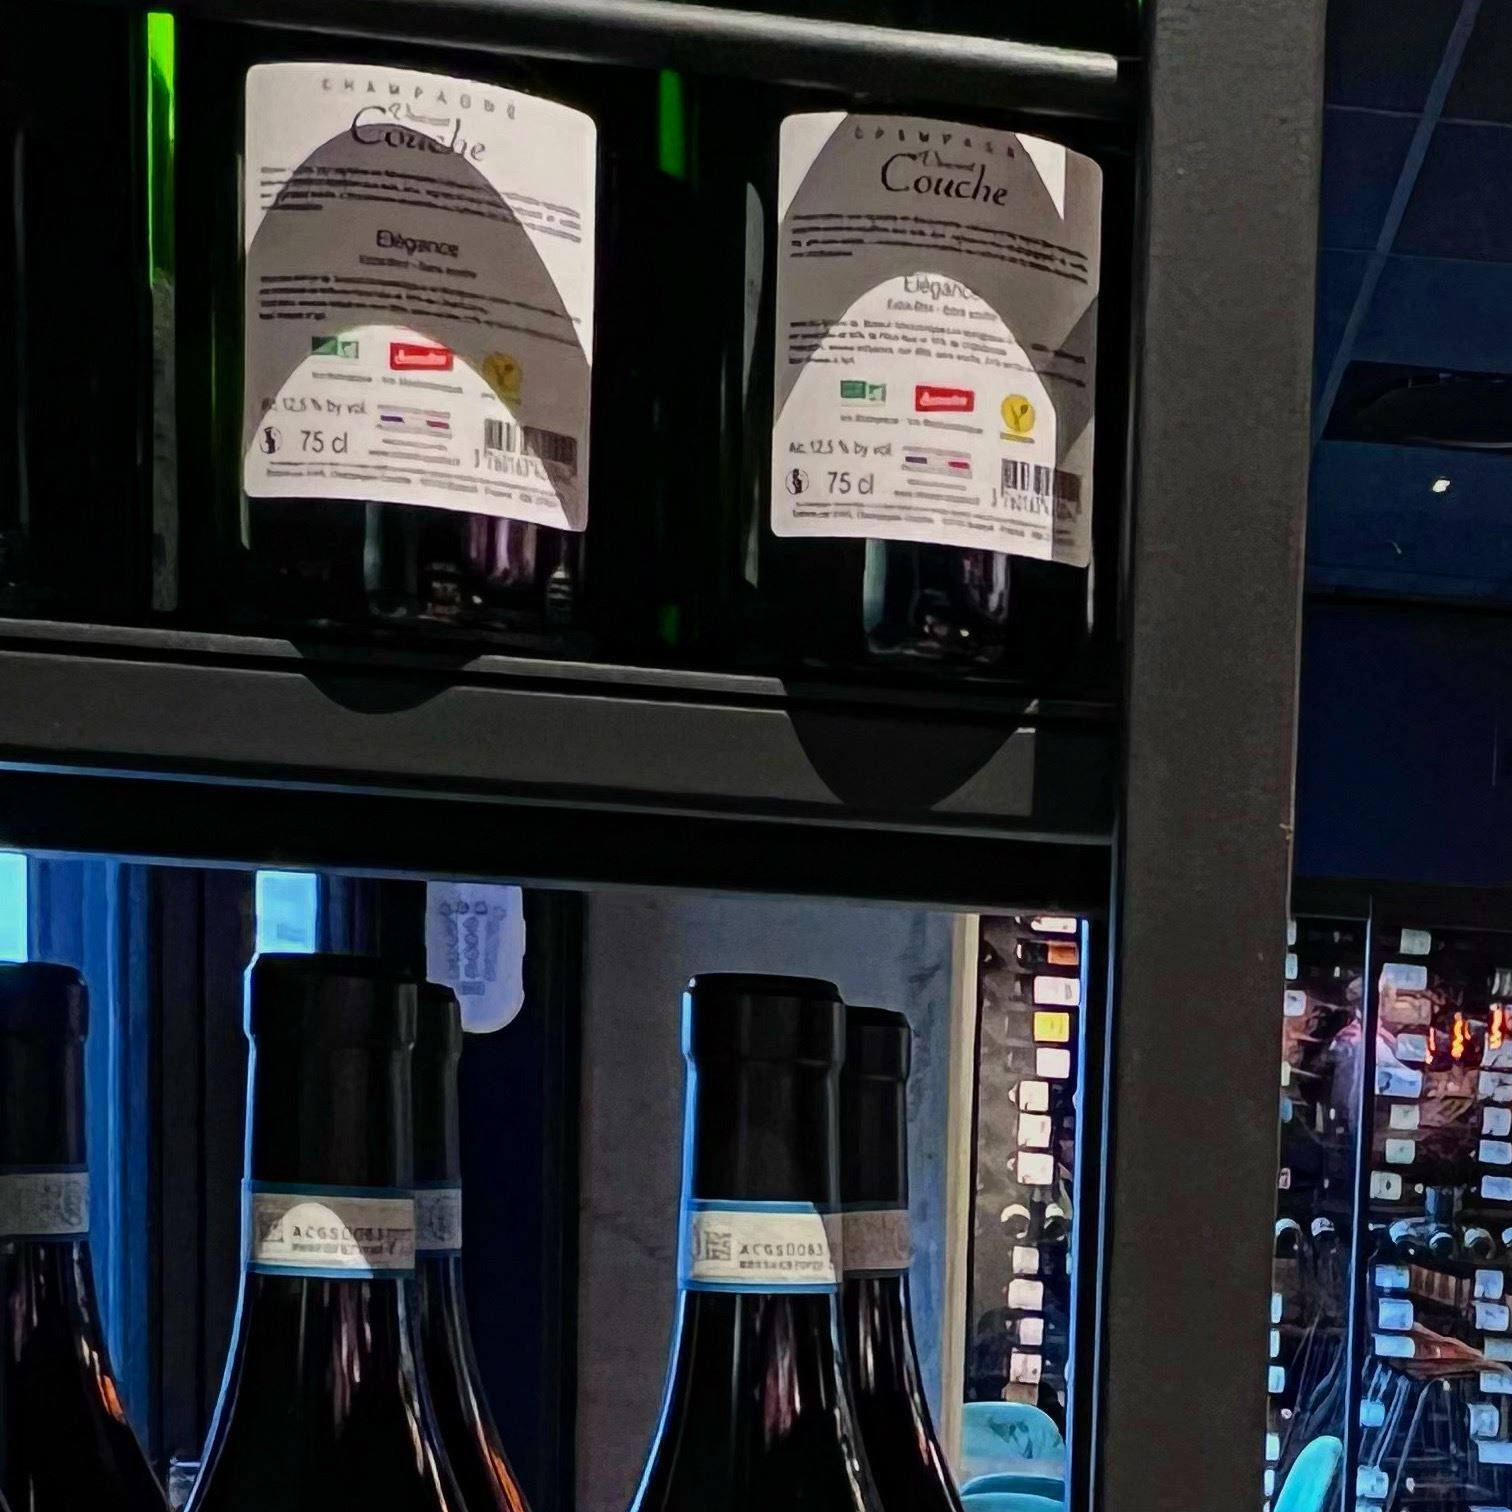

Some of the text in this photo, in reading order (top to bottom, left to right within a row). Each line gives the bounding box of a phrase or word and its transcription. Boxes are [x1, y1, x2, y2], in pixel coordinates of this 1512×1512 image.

[352, 105, 486, 161] Couche
[881, 152, 1008, 206] Couche
[301, 430, 348, 454] 75 cl
[827, 471, 874, 495] 75 cl
